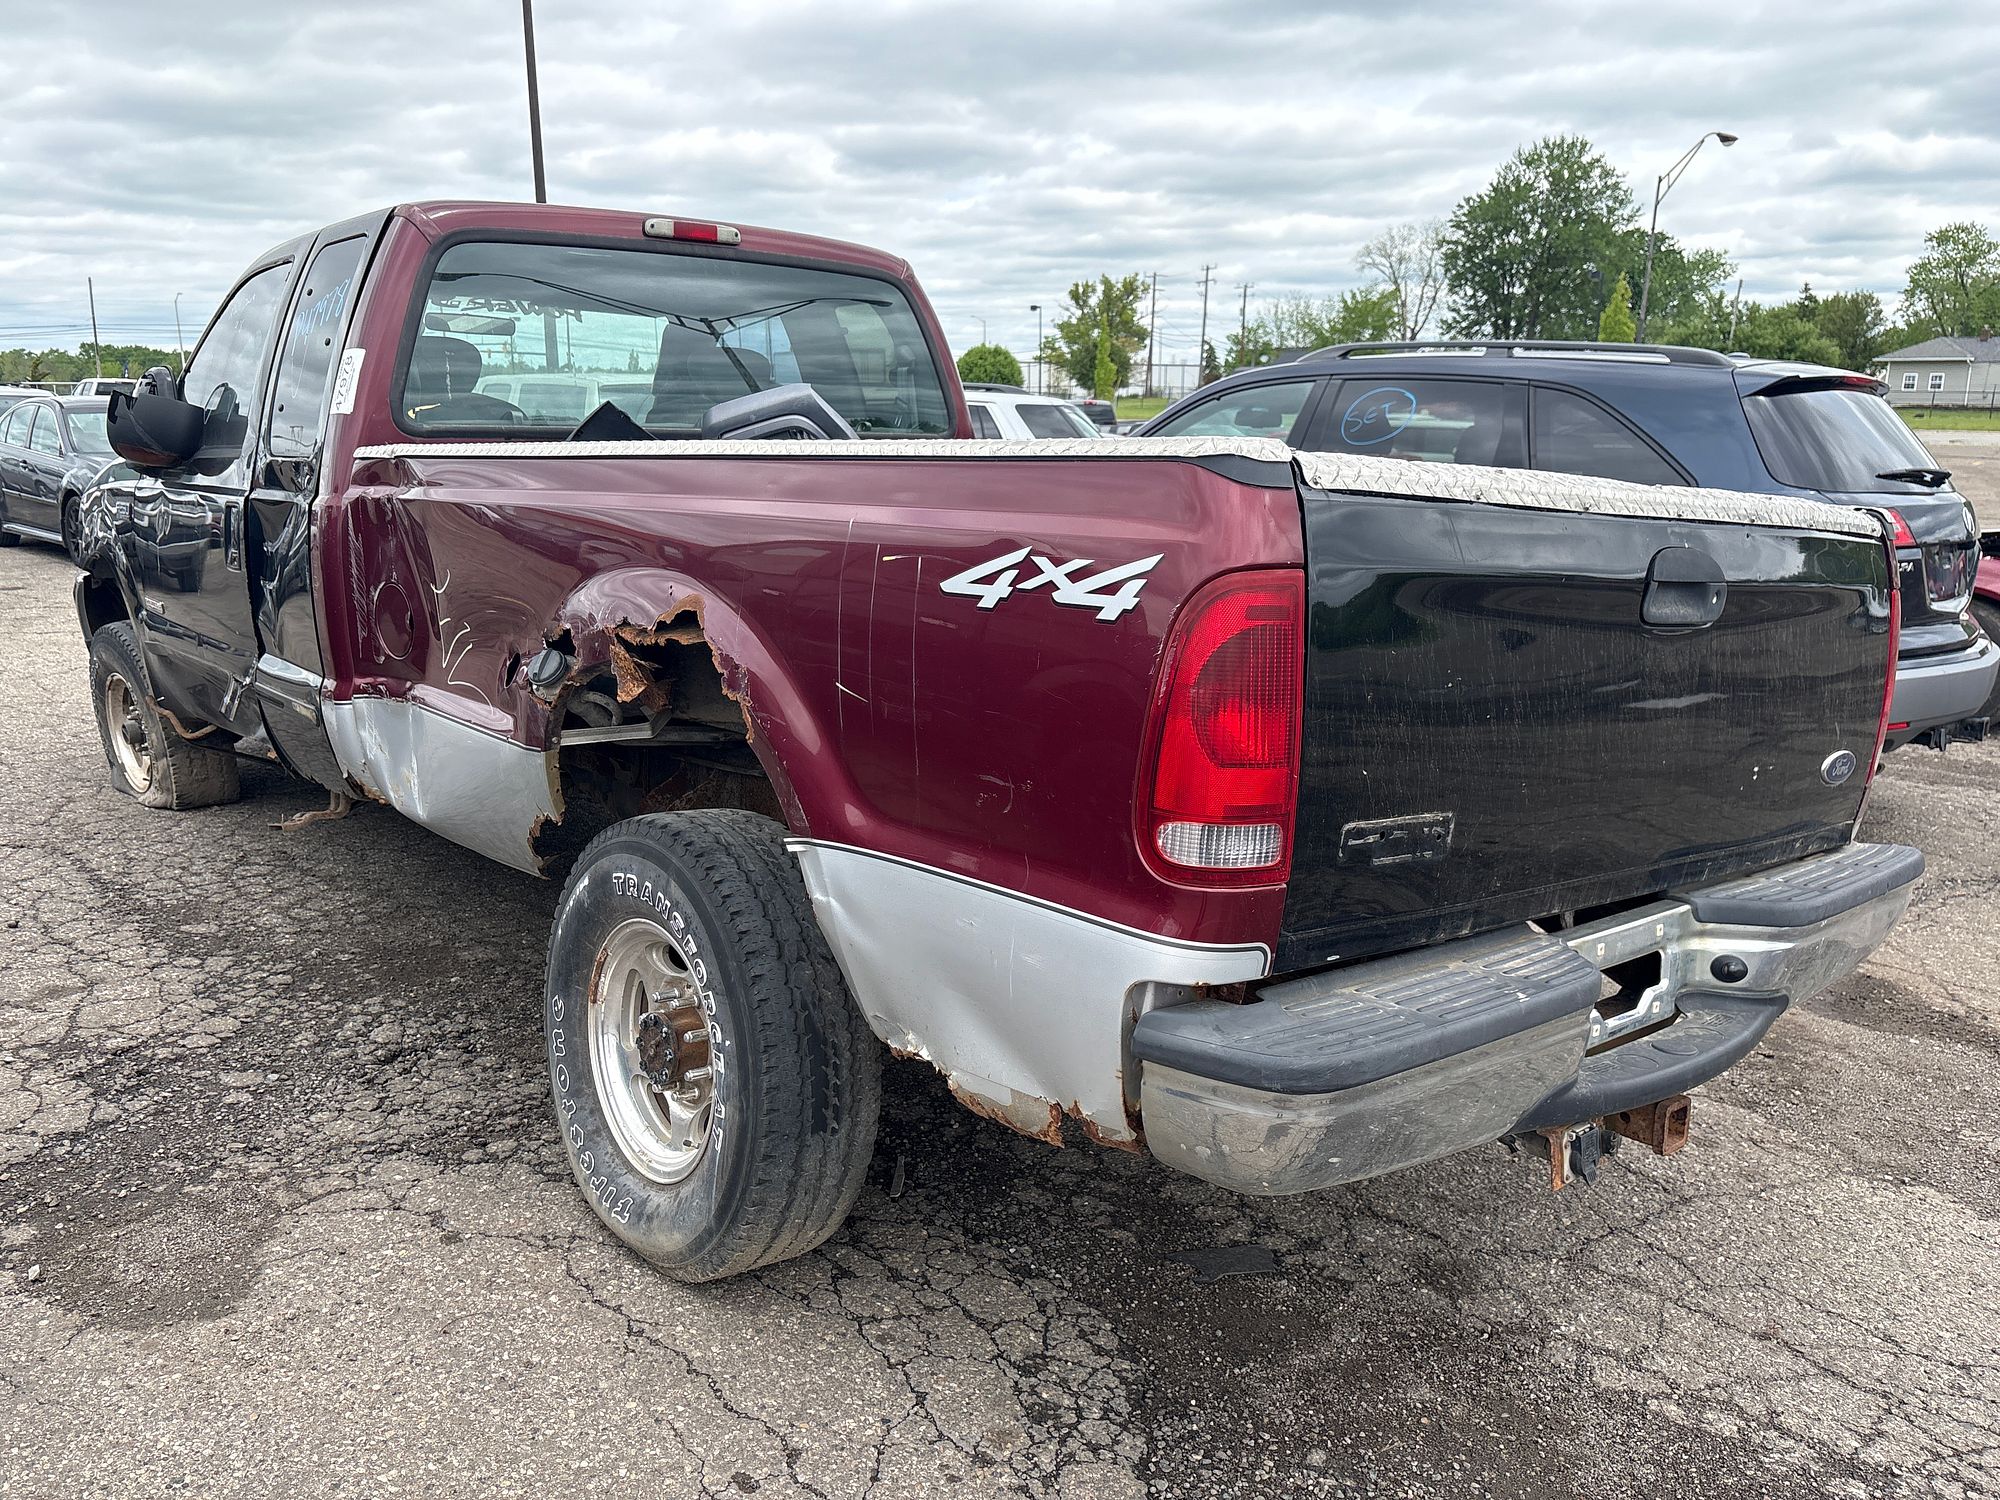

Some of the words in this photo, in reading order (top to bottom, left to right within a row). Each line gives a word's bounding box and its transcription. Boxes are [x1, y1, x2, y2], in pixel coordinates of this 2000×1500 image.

[335, 355, 353, 411] 47978
[1346, 401, 1398, 433] SET
[1827, 753, 1853, 780] Ford
[612, 872, 725, 1074] TRANSFORCE
